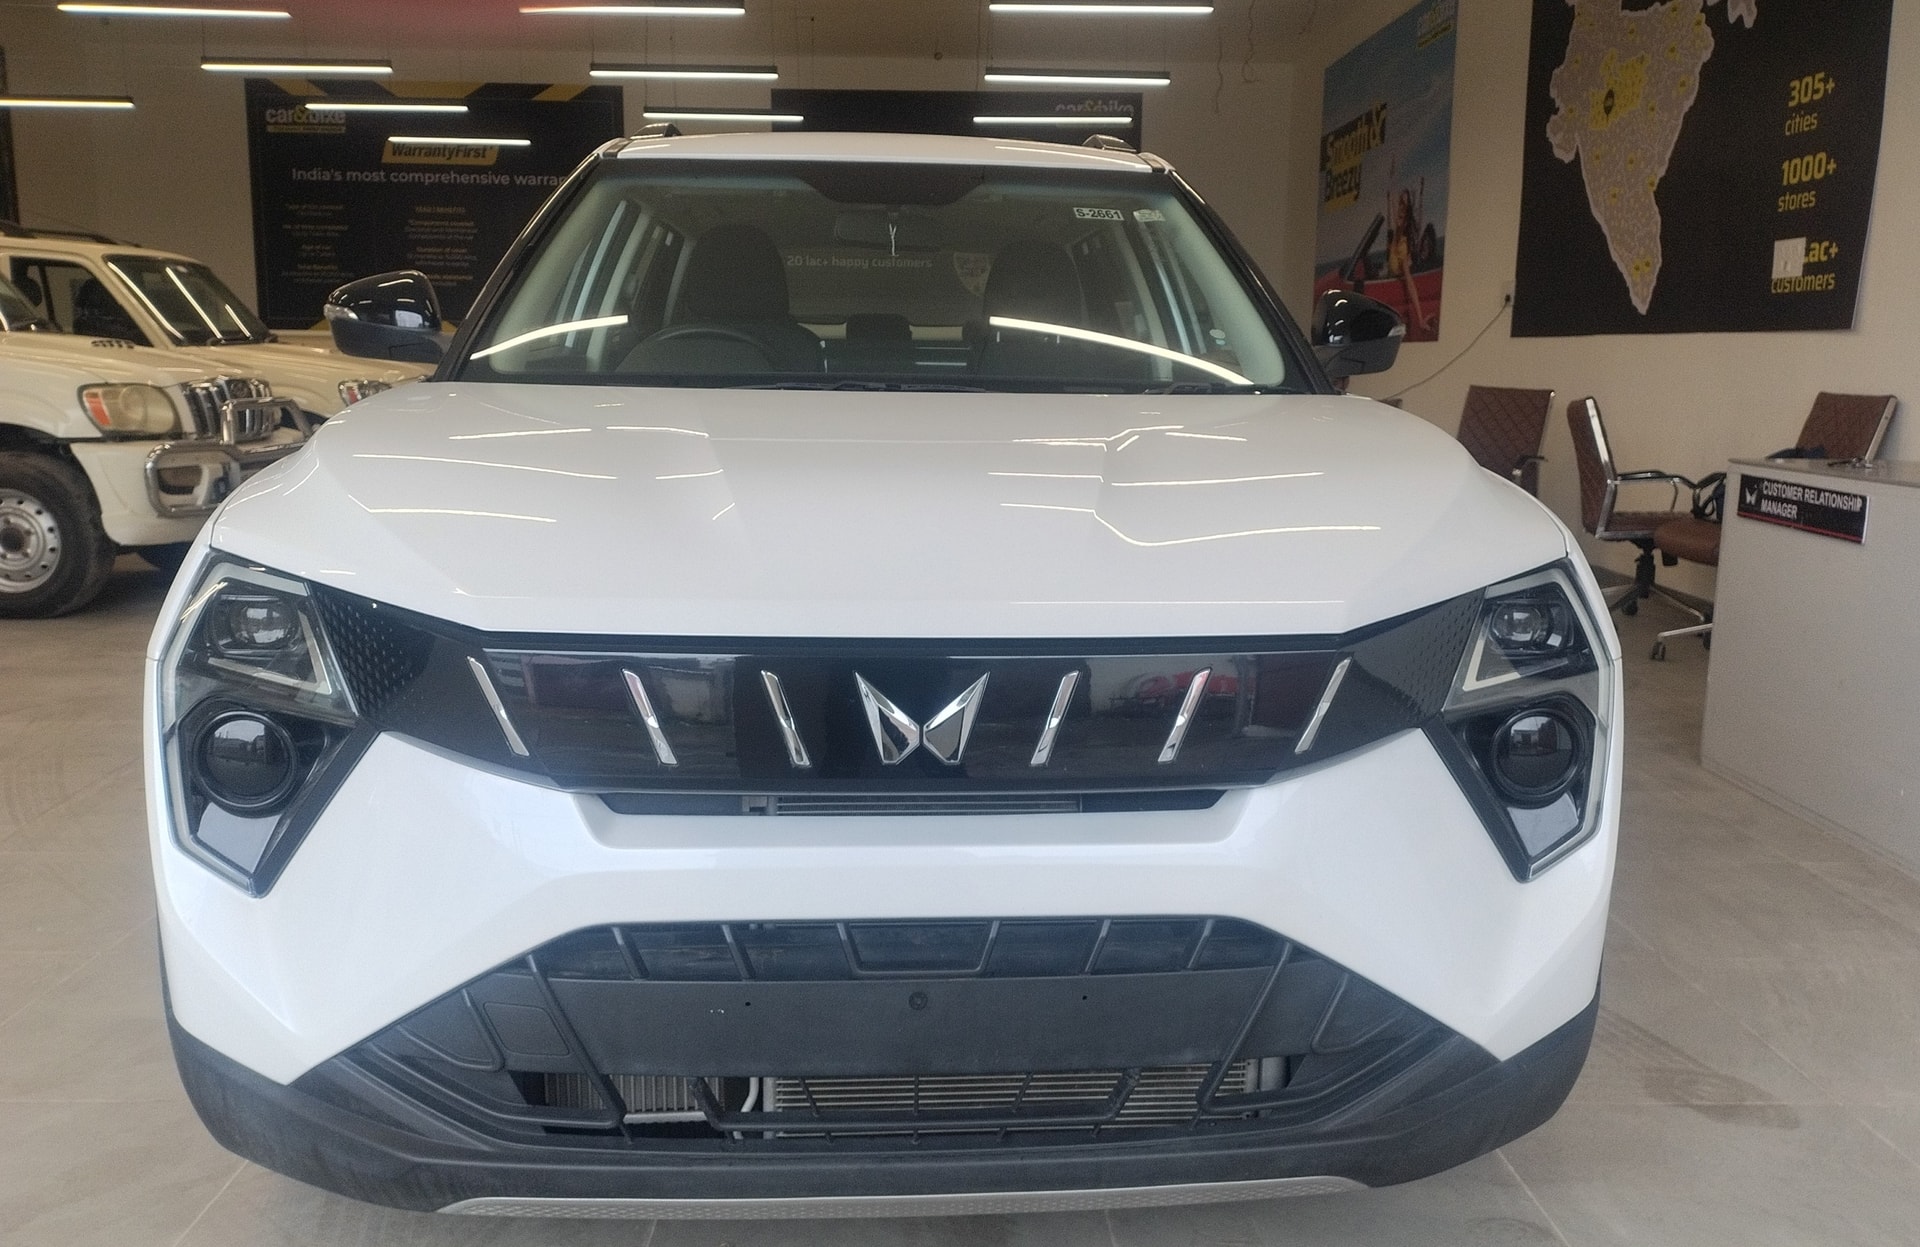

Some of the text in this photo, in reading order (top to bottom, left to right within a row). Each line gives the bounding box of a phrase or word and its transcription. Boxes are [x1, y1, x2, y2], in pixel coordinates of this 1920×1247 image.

[1788, 72, 1836, 107] 305+
[1785, 111, 1818, 136] cities
[291, 168, 343, 182] India's
[346, 169, 387, 182] most
[389, 170, 510, 186] comprehensive
[1782, 152, 1837, 186] 1000+
[1778, 190, 1816, 212] stores
[1076, 208, 1121, 219] S-2661
[786, 255, 803, 267] 20
[831, 255, 869, 270] happy
[871, 255, 933, 269] customers
[1804, 241, 1839, 263] ac+
[1771, 273, 1836, 294] customers
[1762, 480, 1862, 512] CUSTOMER RELATIONSHIP
[1760, 499, 1798, 519] MANAGER
